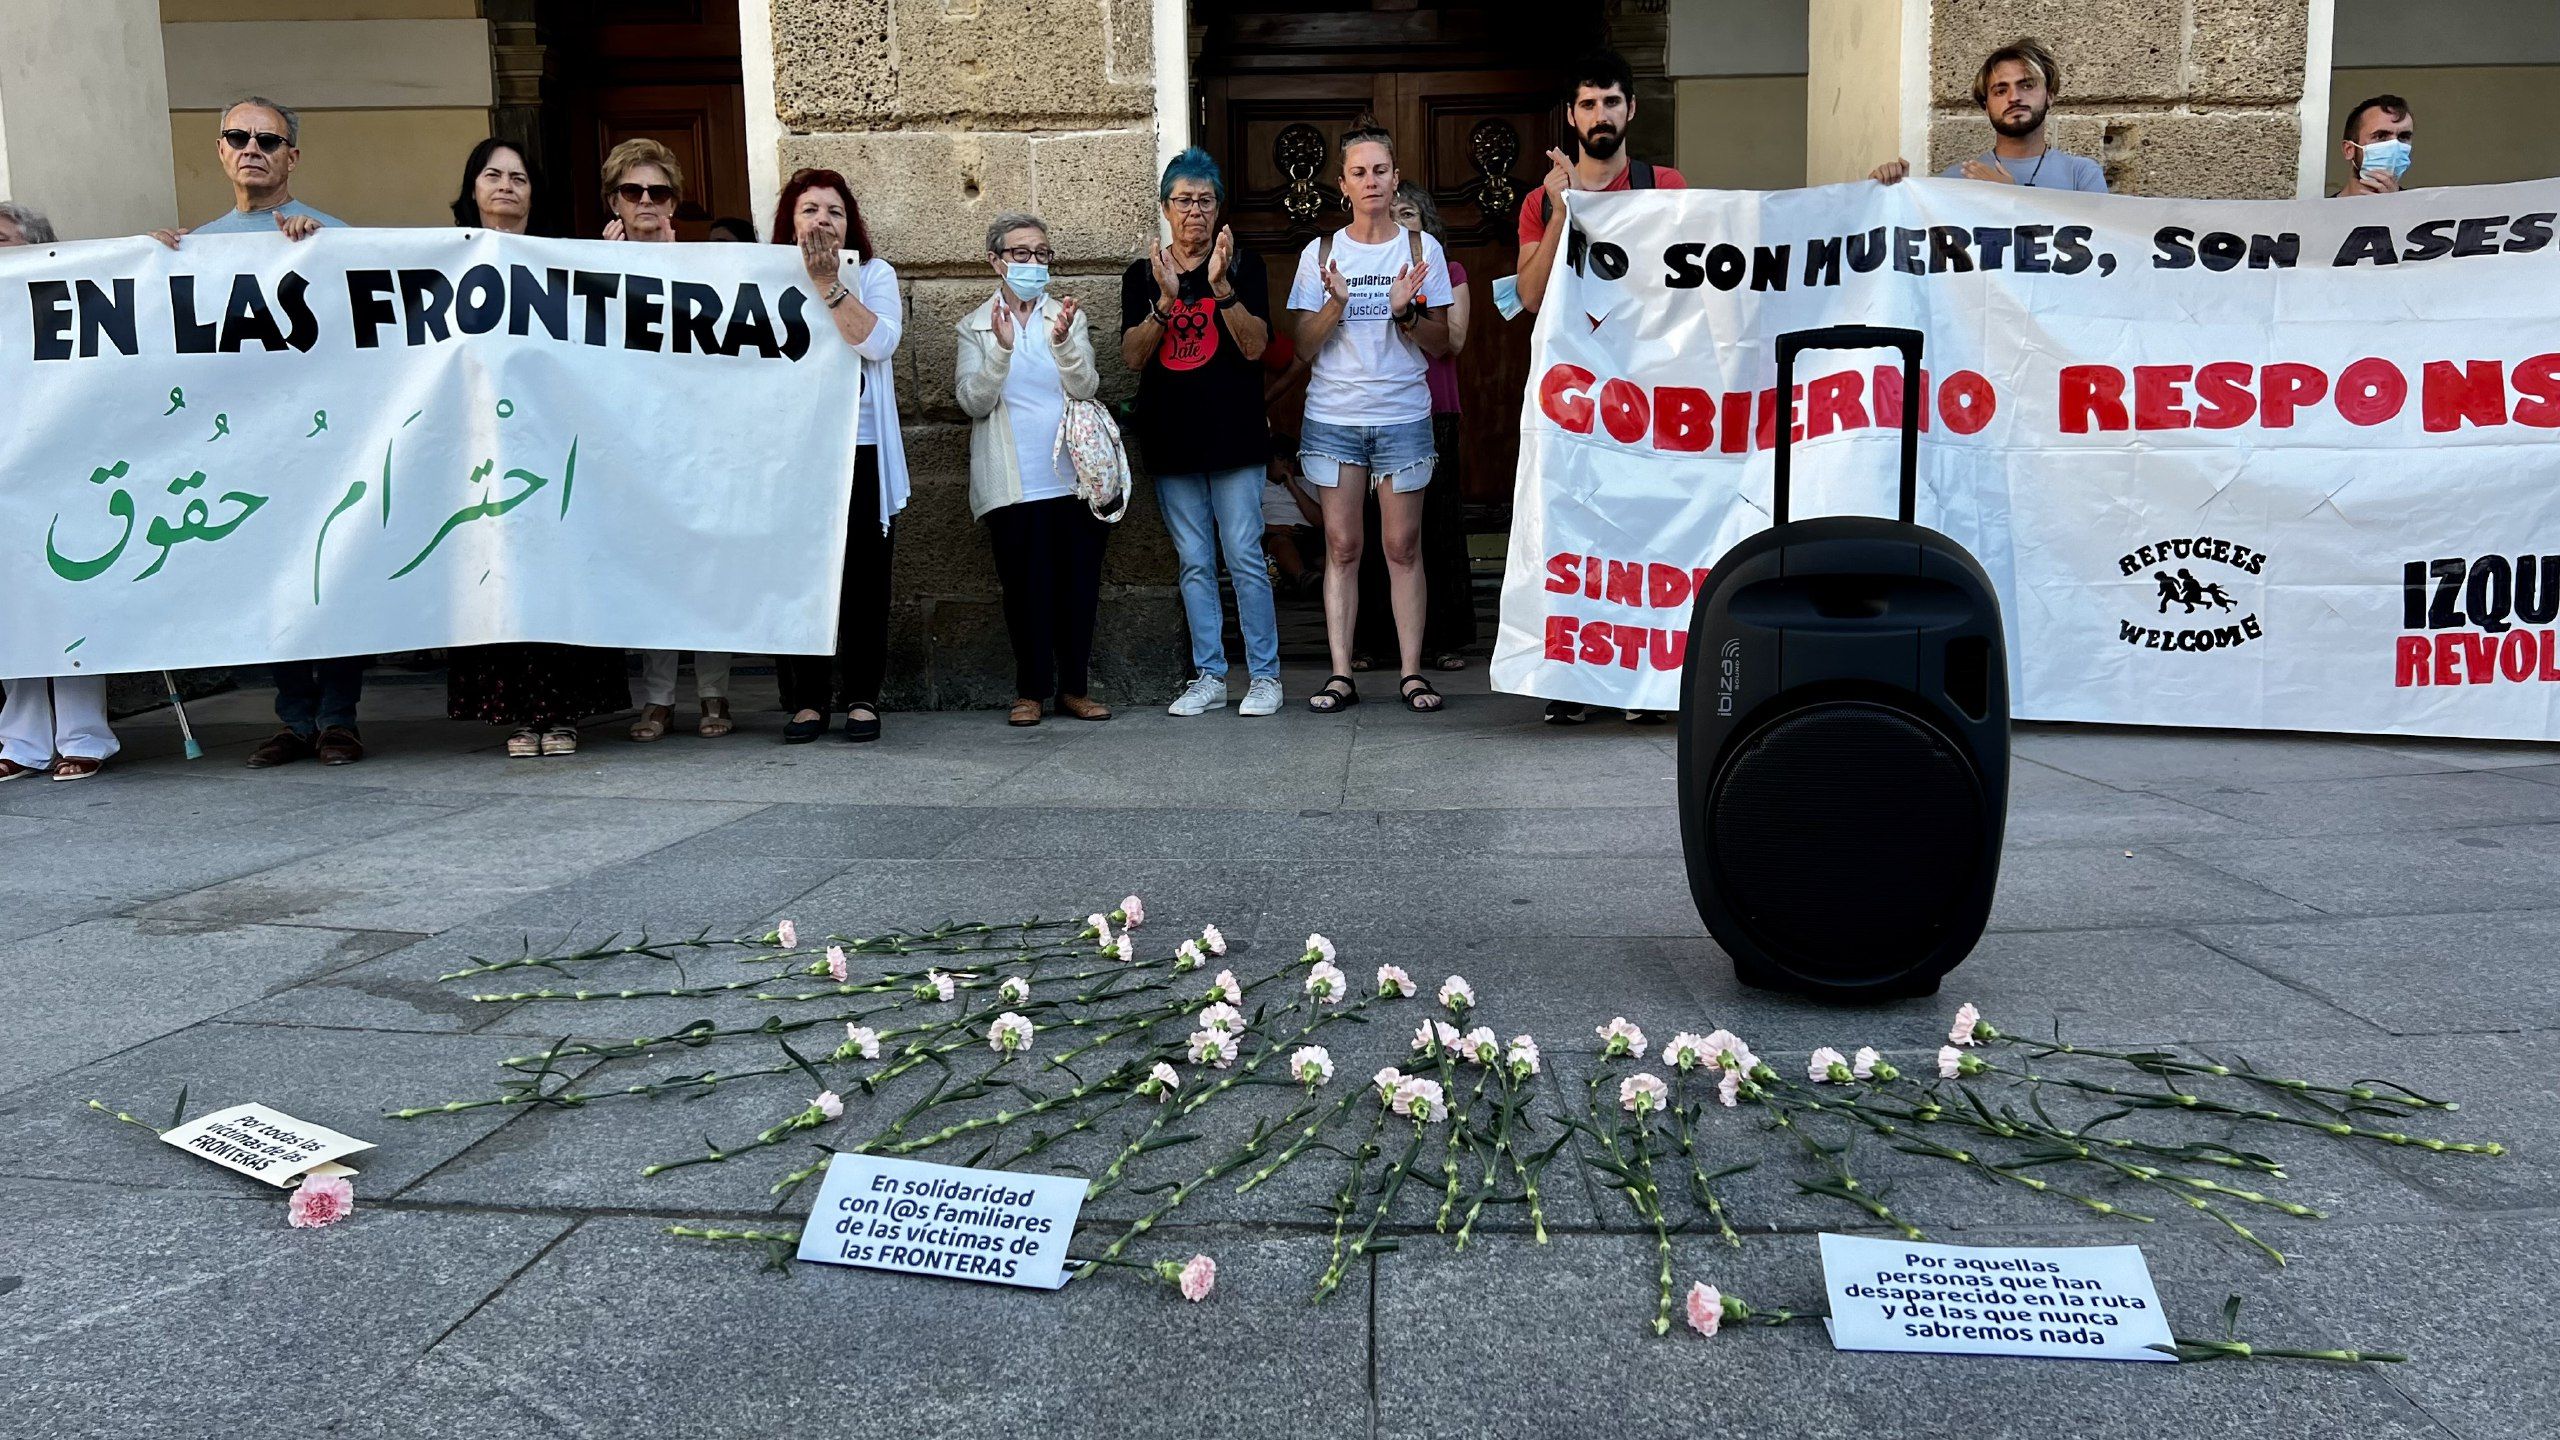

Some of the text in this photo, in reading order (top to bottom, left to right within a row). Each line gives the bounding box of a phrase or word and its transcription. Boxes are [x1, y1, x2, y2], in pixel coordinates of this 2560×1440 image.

[1566, 212, 2560, 292] NO SON MUERTES, SON ASES
[27, 263, 811, 363] EN LAS FRONTERAS
[1348, 304, 1388, 318] justicia
[1168, 334, 1203, 361] Late
[1540, 352, 2560, 454] GOBIERNO RESPONS
[2118, 536, 2267, 577] REFUGEES
[2403, 554, 2560, 634] IZQU
[1544, 615, 1689, 671] ESTU
[2118, 612, 2263, 653] WELCOME
[2395, 628, 2560, 688] REVOL
[1717, 659, 1733, 716] ibiza
[189, 1134, 277, 1171] FRONTERAS
[206, 1123, 308, 1163] víctimas de las
[233, 1115, 326, 1152] Por todas las
[871, 1174, 1035, 1208] En solidaridad
[835, 1215, 1040, 1256] de las víctimas de
[839, 1197, 1053, 1234] con l@s familiares
[840, 1239, 1019, 1279] las FRONTERAS
[1905, 1253, 2060, 1273] Por aquellas
[1844, 1283, 2147, 1309] desaparecido en la ruta
[1876, 1271, 2102, 1292] personas que han
[1881, 1302, 2119, 1326] y de las que nunca
[1904, 1320, 2105, 1345] sabremos nada
